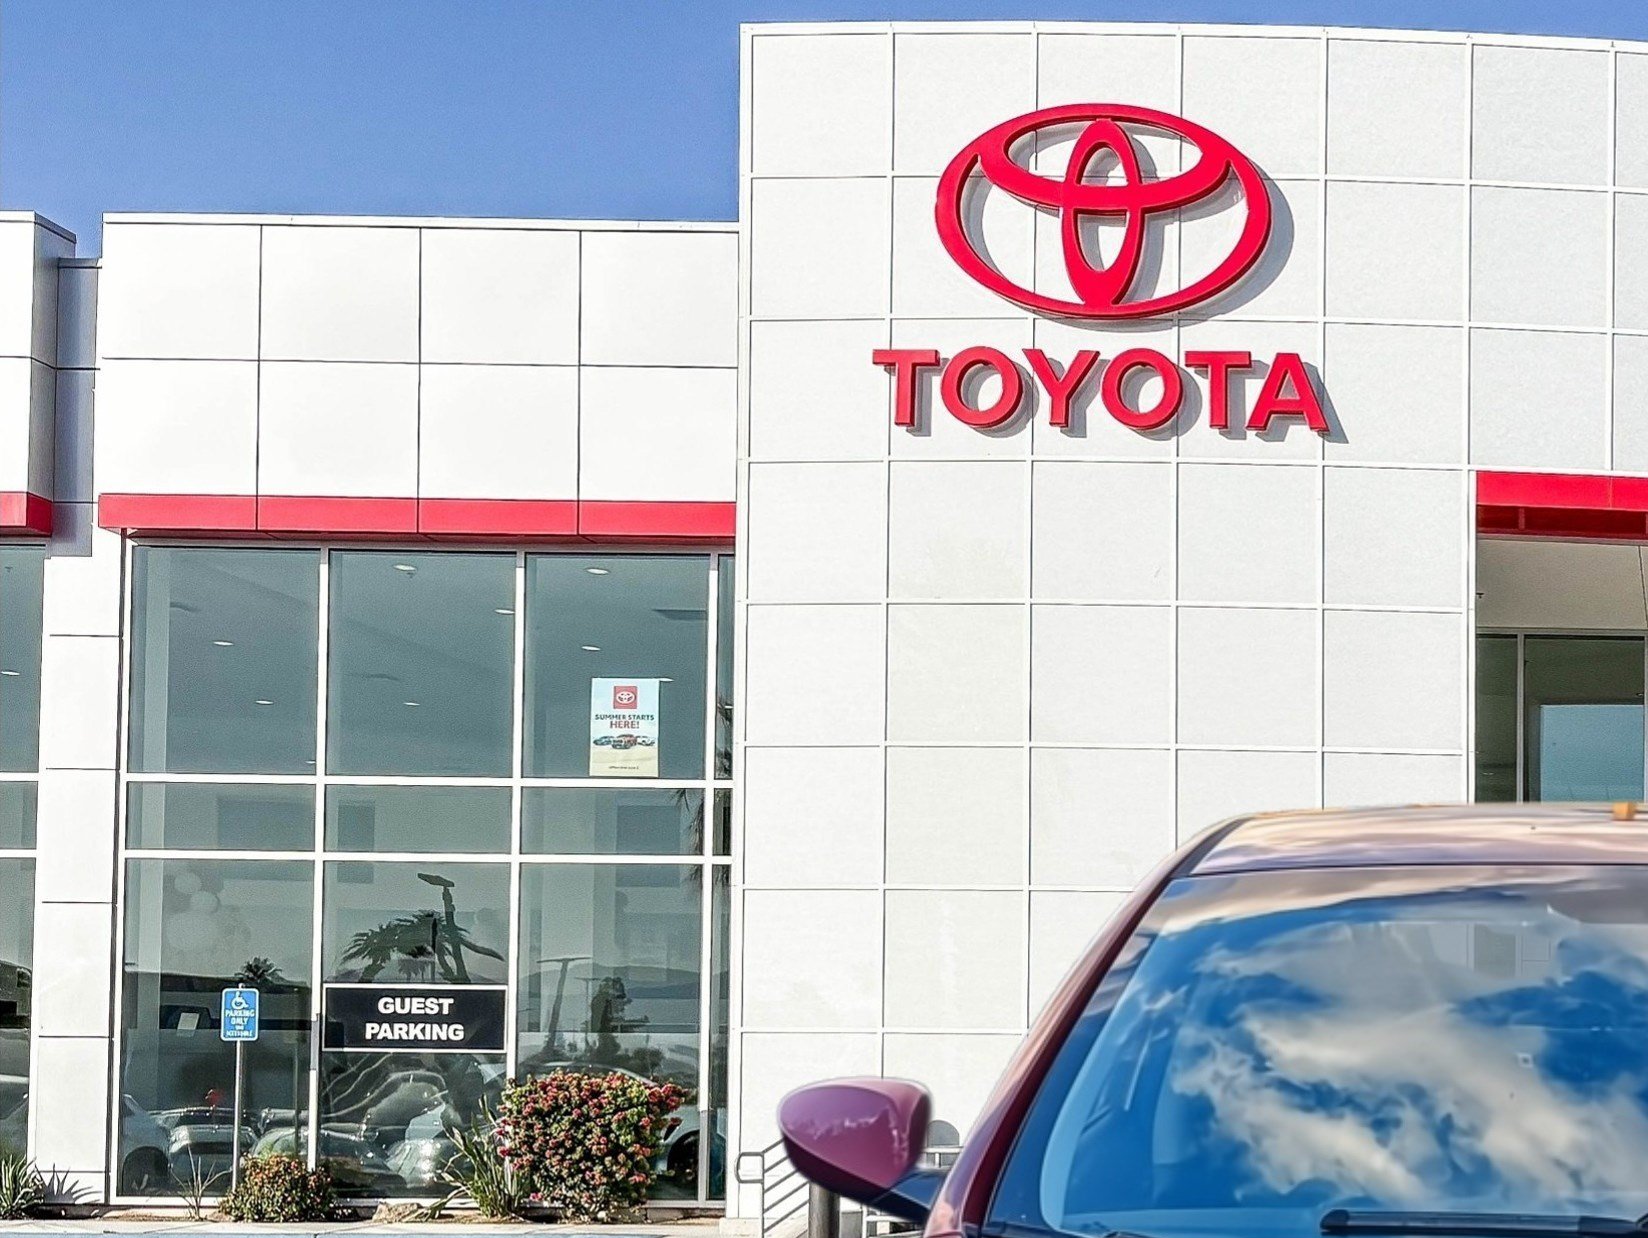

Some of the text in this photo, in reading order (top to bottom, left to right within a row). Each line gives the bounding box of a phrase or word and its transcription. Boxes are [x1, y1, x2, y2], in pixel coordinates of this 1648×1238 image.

[873, 347, 1329, 432] TOYOTA
[609, 721, 640, 729] HERE!
[377, 996, 455, 1015] GUEST
[225, 1009, 255, 1017] PARKING
[230, 1017, 249, 1025] ONLY
[365, 1022, 465, 1041] PARKING
